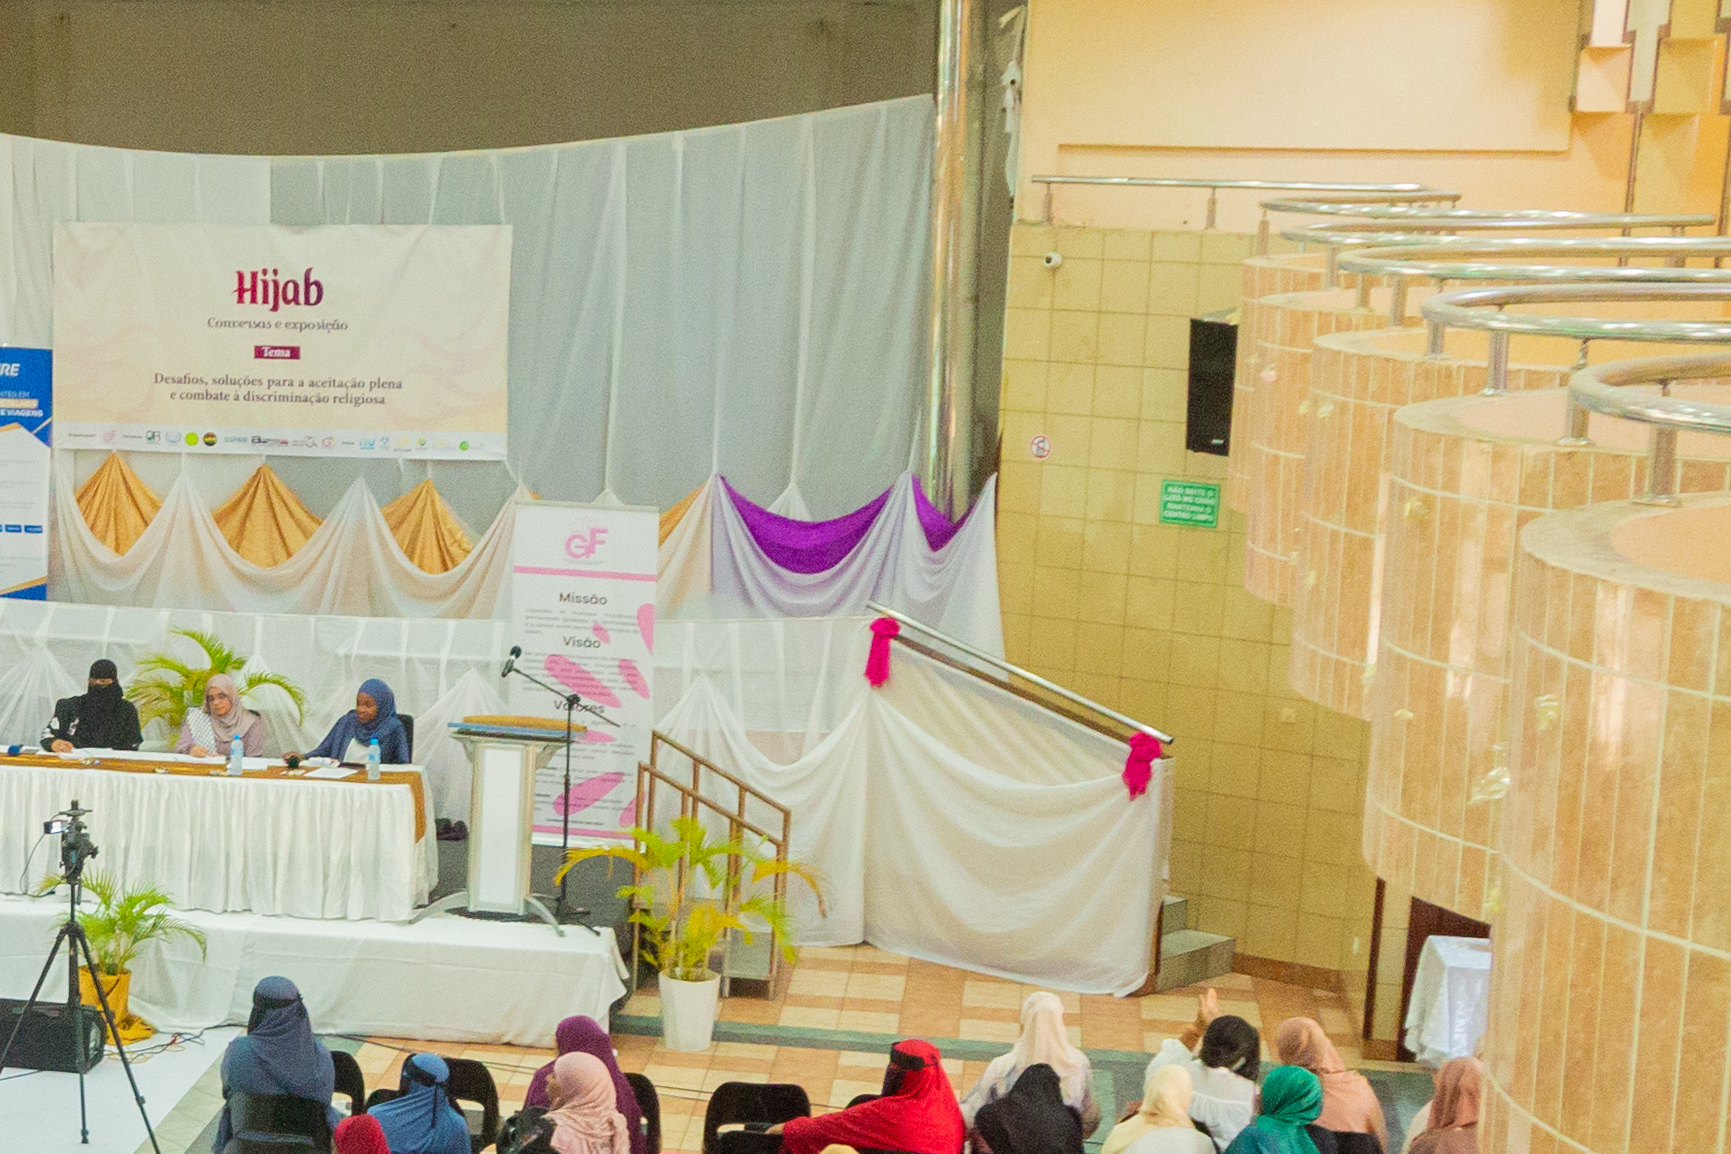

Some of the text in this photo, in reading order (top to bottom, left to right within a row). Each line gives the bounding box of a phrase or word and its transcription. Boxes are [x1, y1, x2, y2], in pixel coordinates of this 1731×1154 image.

[232, 267, 324, 312] Hijab
[207, 317, 349, 333] Conversas e exposição
[261, 346, 291, 358] Tema
[154, 373, 403, 391] Desafios, soluções para a aceitação plena
[170, 391, 177, 400] e
[179, 390, 230, 401] combate
[243, 391, 329, 405] discriminação
[333, 392, 386, 407] religiosa
[565, 528, 609, 559] GF
[559, 592, 608, 605] Missão
[563, 636, 602, 649] Visão
